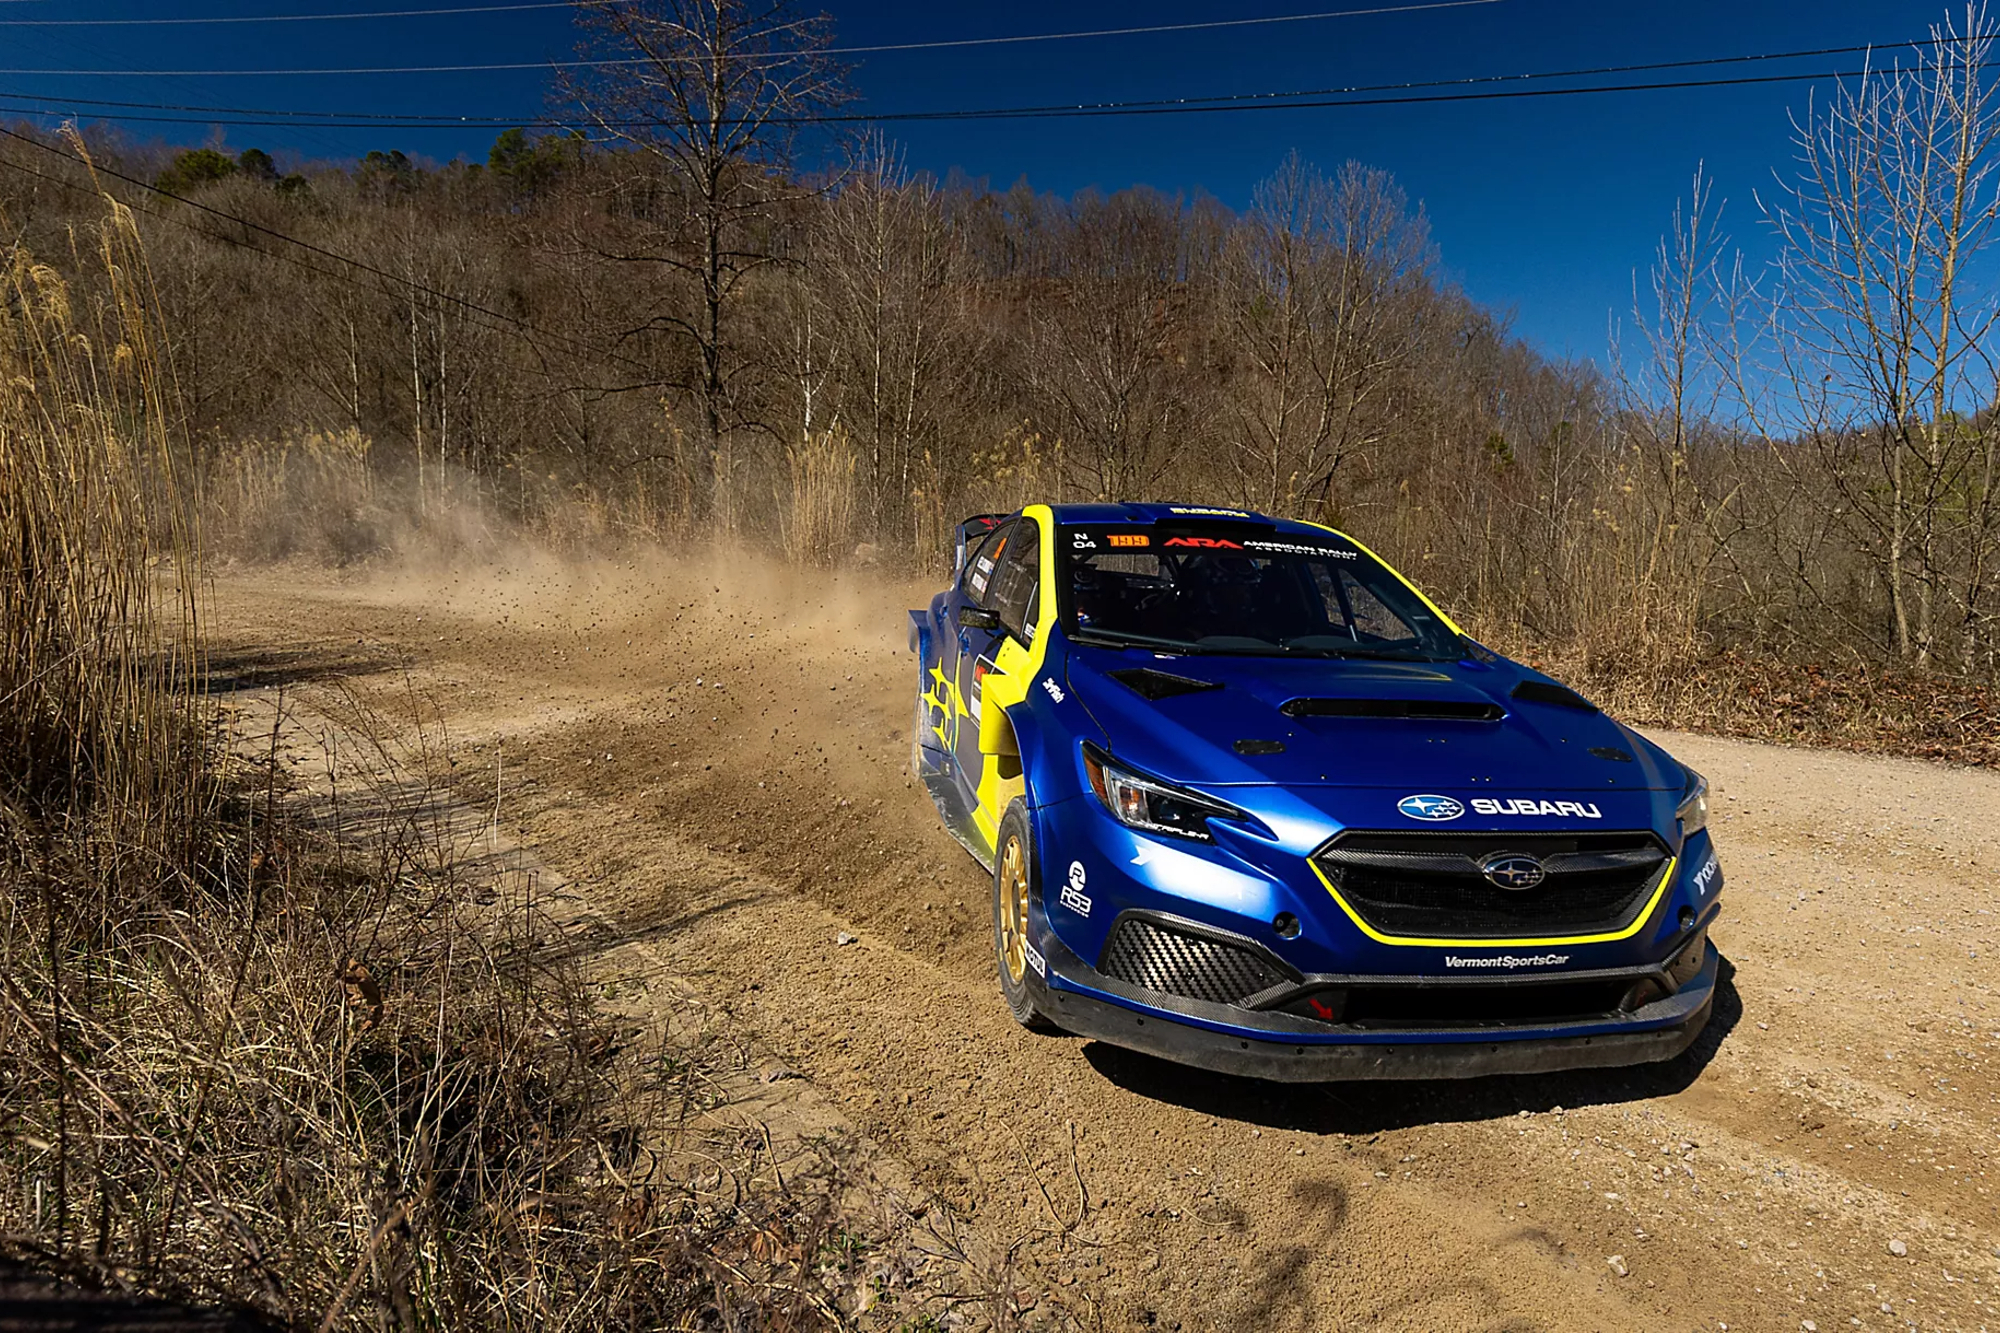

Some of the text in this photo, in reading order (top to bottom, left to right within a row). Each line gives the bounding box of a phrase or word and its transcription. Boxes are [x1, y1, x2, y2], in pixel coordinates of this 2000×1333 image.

[1074, 532, 1089, 541] N
[1106, 534, 1150, 547] 199
[1163, 537, 1244, 550] ARA
[1072, 540, 1097, 549] 04
[1243, 540, 1357, 557] AMERICAN RALLY
[1470, 799, 1602, 819] SUBARU
[1060, 885, 1092, 913] R53
[1444, 954, 1569, 969] VermontSportsCar
